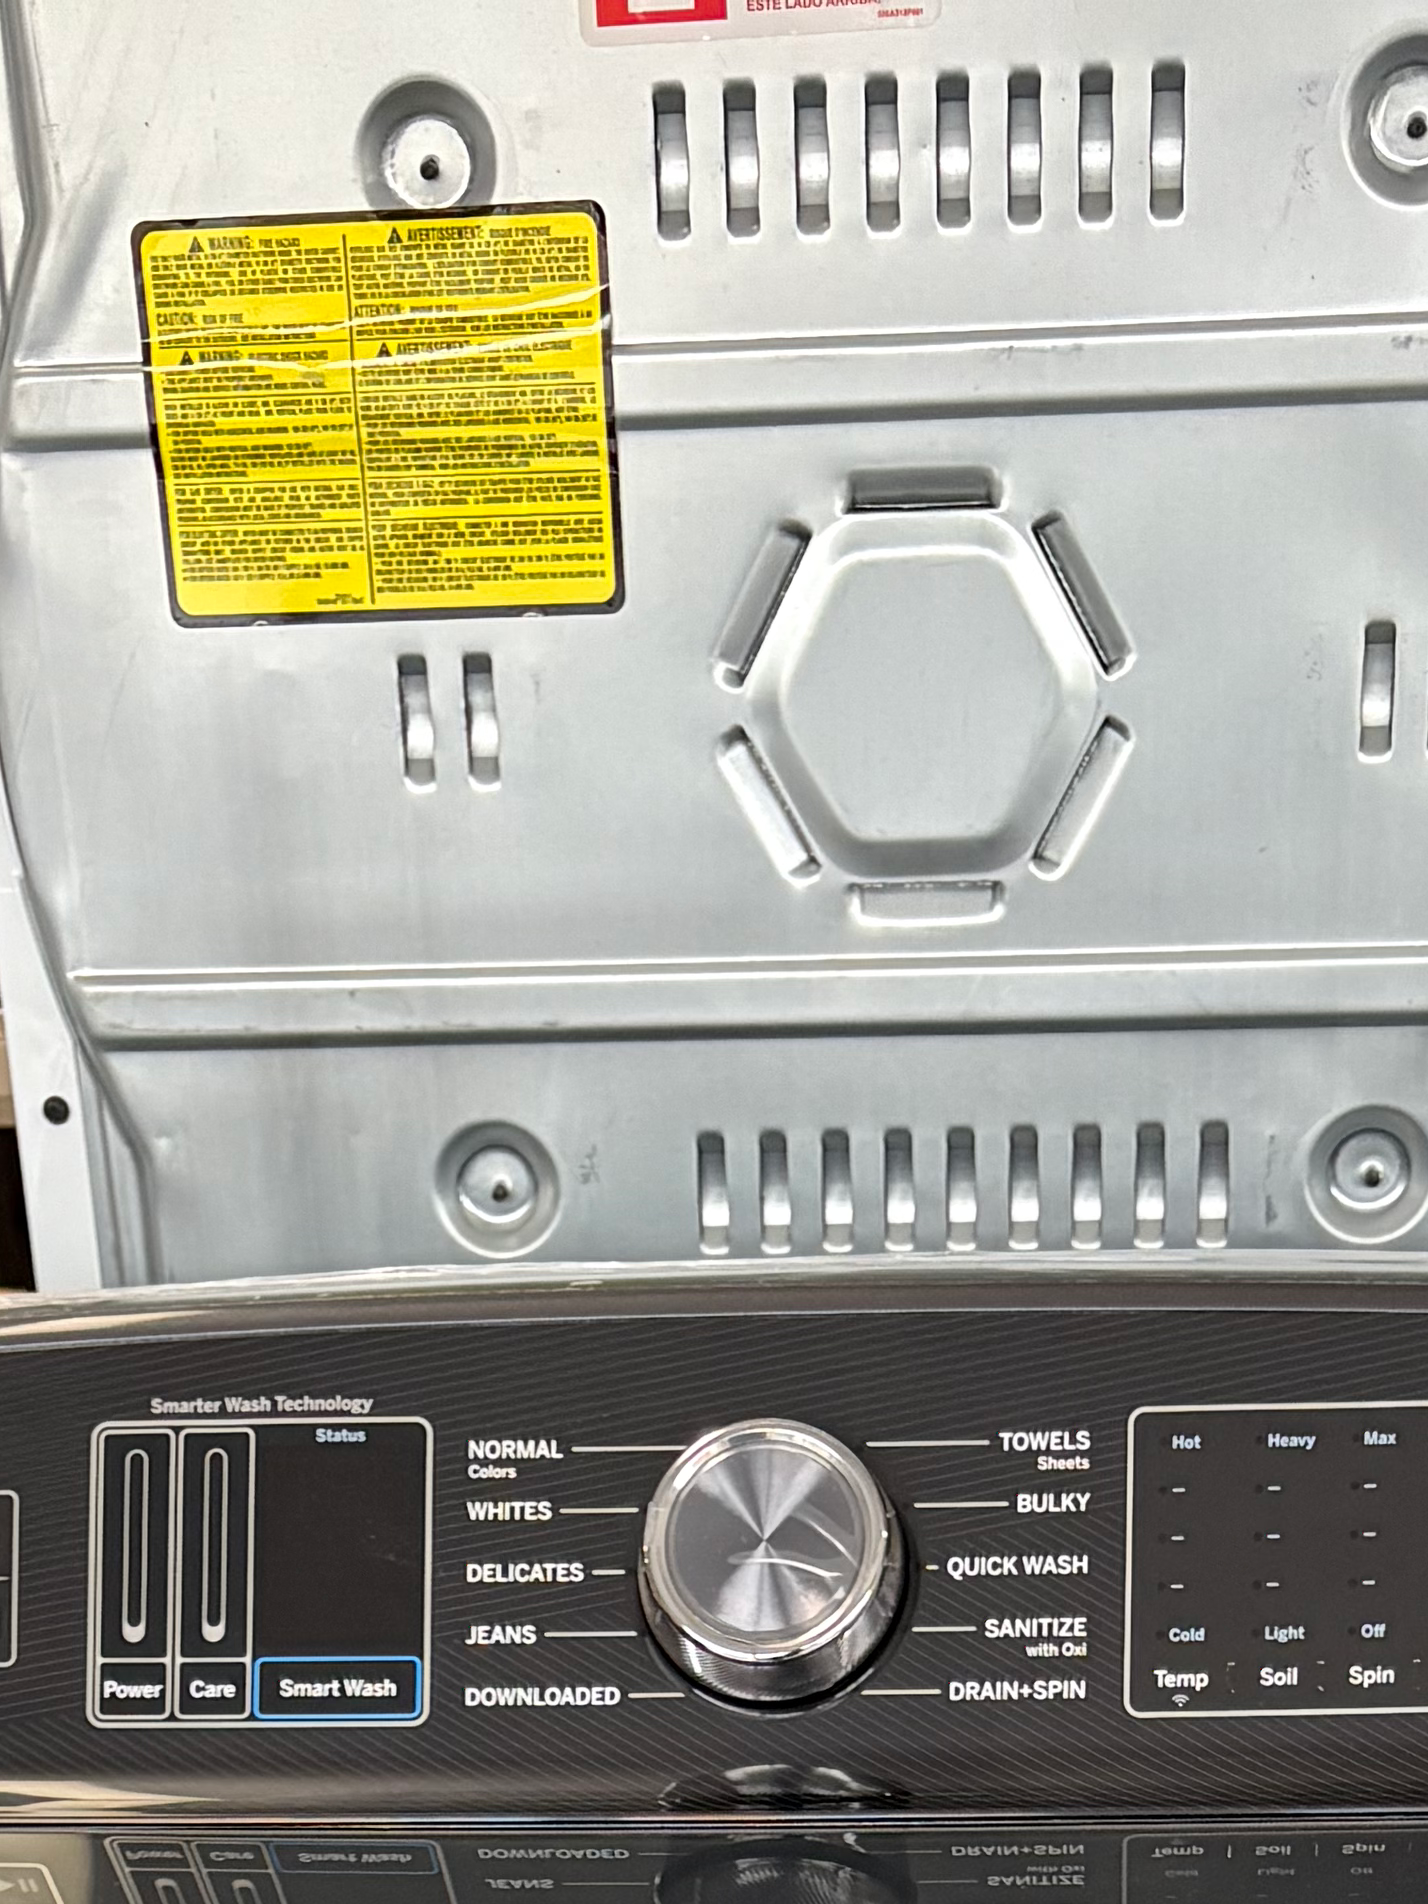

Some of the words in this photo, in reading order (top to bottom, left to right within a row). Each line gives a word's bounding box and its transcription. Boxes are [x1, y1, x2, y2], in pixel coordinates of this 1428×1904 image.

[746, 0, 782, 12] ESTE
[150, 1396, 223, 1415] Smarter
[225, 1395, 271, 1413] Wash
[274, 1394, 374, 1416] Technology
[315, 1427, 367, 1443] Status
[998, 1430, 1091, 1452] TOWELS
[1172, 1433, 1201, 1451] Hot
[1267, 1432, 1316, 1452] Heavy
[1363, 1430, 1397, 1447] Max
[467, 1439, 564, 1461] NORMAL
[467, 1463, 517, 1480] Colors
[1037, 1454, 1090, 1470] Sheets
[466, 1501, 553, 1522] WHITES
[1016, 1492, 1091, 1513] BULKY
[465, 1562, 585, 1584] DELICATES
[946, 1556, 1015, 1579] QUICK
[1017, 1555, 1089, 1577] WASH
[464, 1624, 537, 1646] JEANS
[984, 1617, 1088, 1639] SANITIZE
[1168, 1626, 1205, 1643] Cold
[1264, 1625, 1306, 1644] Light
[1360, 1622, 1386, 1639] Off
[1025, 1642, 1058, 1658] with
[1061, 1641, 1088, 1657] Oxi
[1154, 1669, 1210, 1691] Temp
[1259, 1667, 1298, 1687] Soil
[1348, 1665, 1396, 1689] Spin
[103, 1679, 163, 1702] Power
[189, 1679, 237, 1700] Care
[279, 1678, 340, 1699] Smart
[344, 1678, 398, 1698] Wash
[464, 1685, 621, 1708] DOWNLOADED
[948, 1679, 1087, 1702] DRAIN+SPIN
